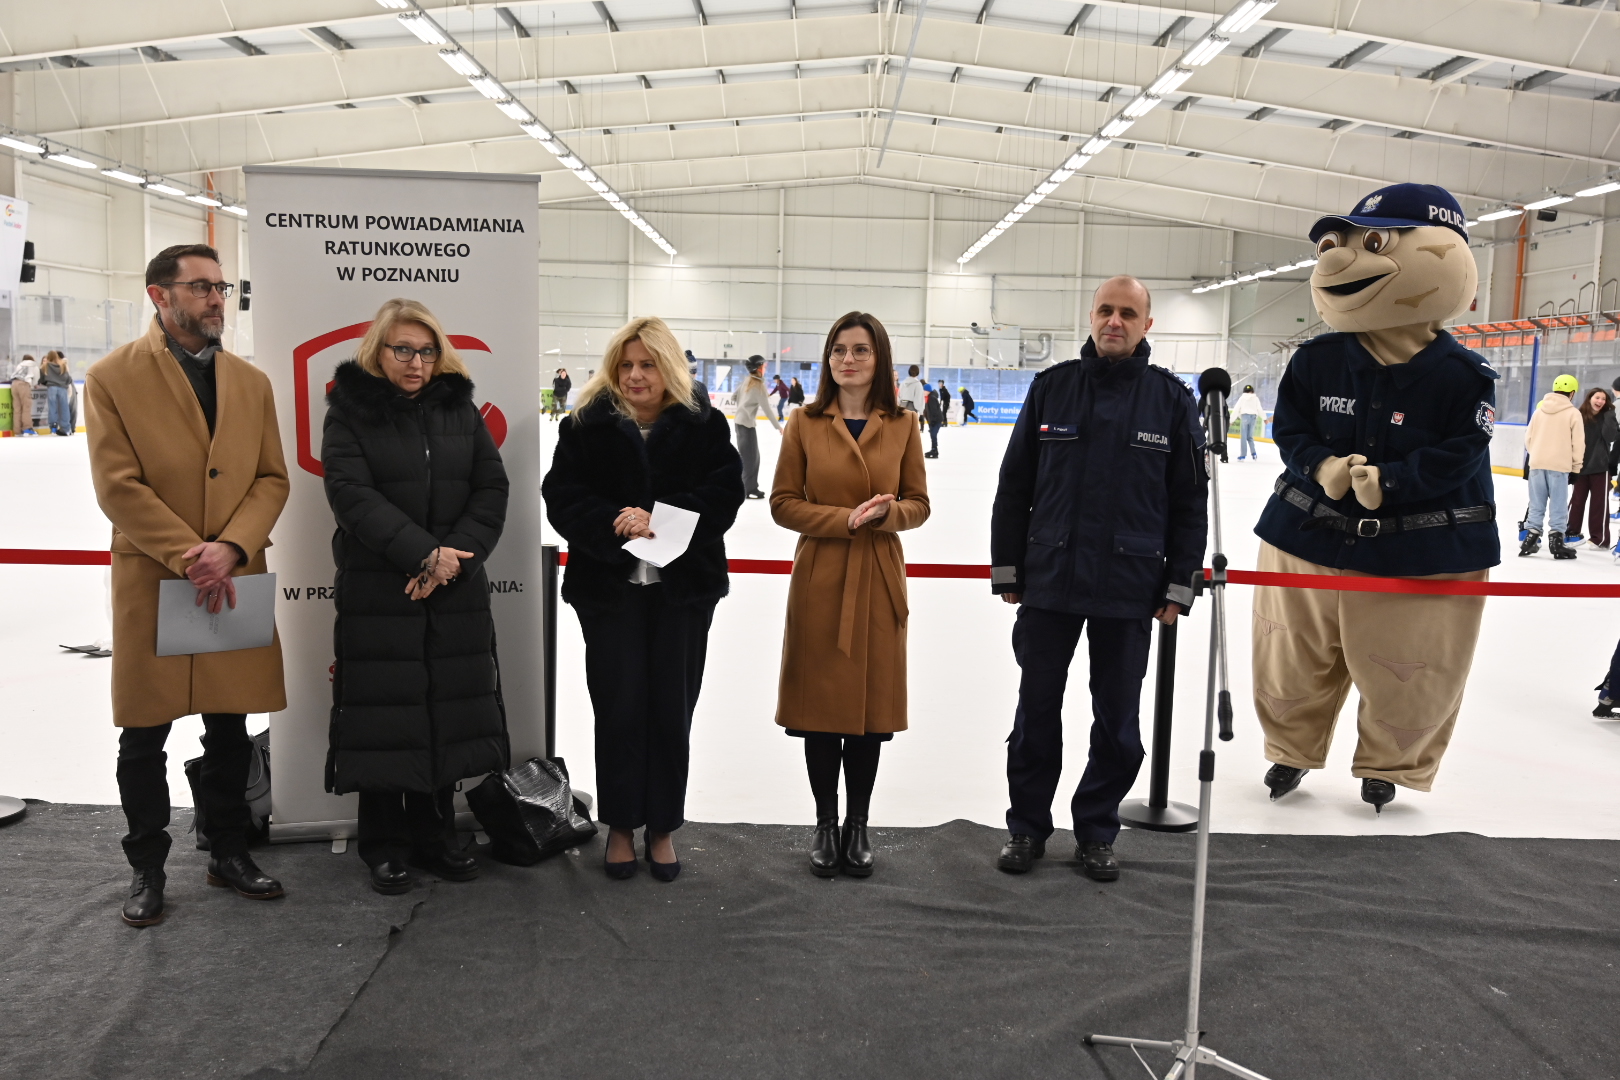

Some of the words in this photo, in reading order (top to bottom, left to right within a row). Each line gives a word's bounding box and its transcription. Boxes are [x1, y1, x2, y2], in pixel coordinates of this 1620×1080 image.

[265, 212, 358, 230] CENTRUM
[365, 215, 525, 233] POWIADAMIANIA
[325, 240, 471, 257] RATUNKOWEGO
[336, 266, 356, 281] W
[362, 267, 459, 283] POZNANIU
[977, 405, 998, 415] Korty
[1000, 406, 1020, 414] tenis
[1319, 396, 1356, 416] PYREK
[1137, 431, 1169, 446] POLICJA
[282, 587, 301, 601] W
[306, 586, 335, 600] PRZ
[489, 580, 523, 594] NIA:
